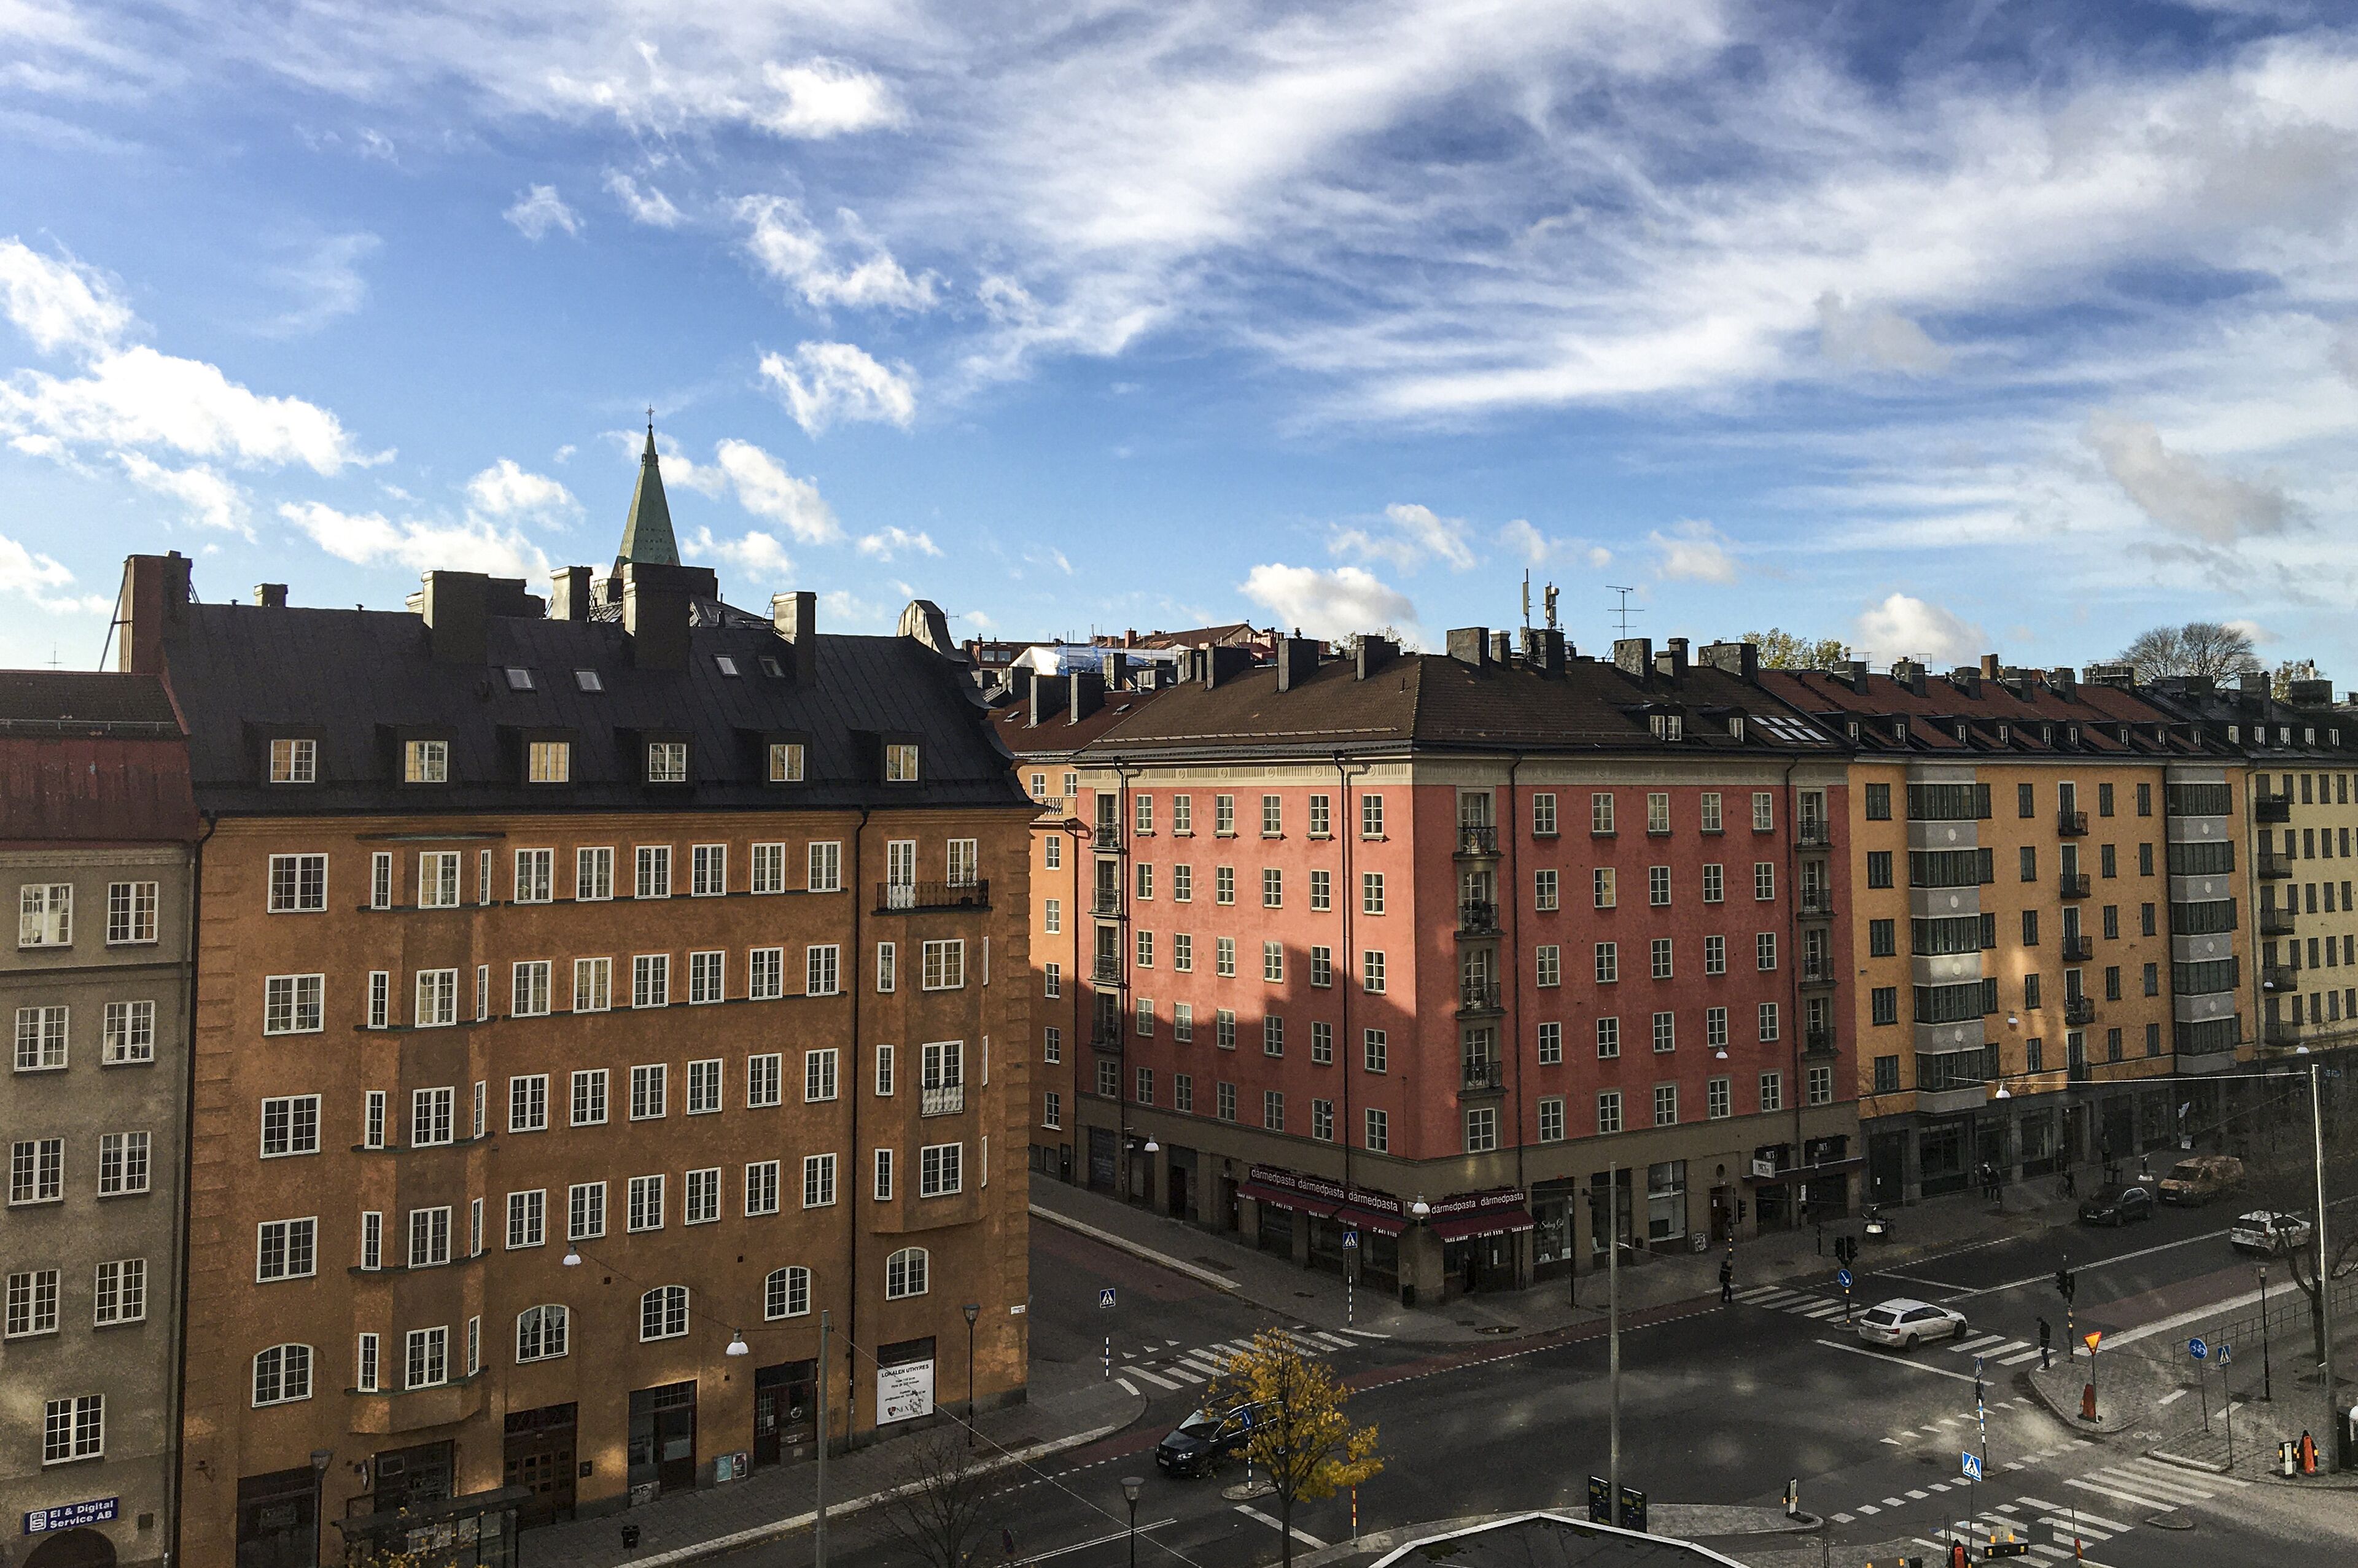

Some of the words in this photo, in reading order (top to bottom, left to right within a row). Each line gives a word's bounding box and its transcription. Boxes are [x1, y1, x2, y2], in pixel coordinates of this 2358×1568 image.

[1251, 1167, 1296, 1186] därmedpasta
[1298, 1178, 1344, 1199] därmedpasta
[1348, 1191, 1398, 1212] därmedpasta
[1431, 1200, 1476, 1214] därmedpasta
[1481, 1192, 1524, 1206] därmedpasta
[906, 1364, 929, 1373] UTHYRES
[77, 1500, 114, 1515] Digital
[50, 1516, 93, 1528] Service
[96, 1510, 112, 1520] AB
